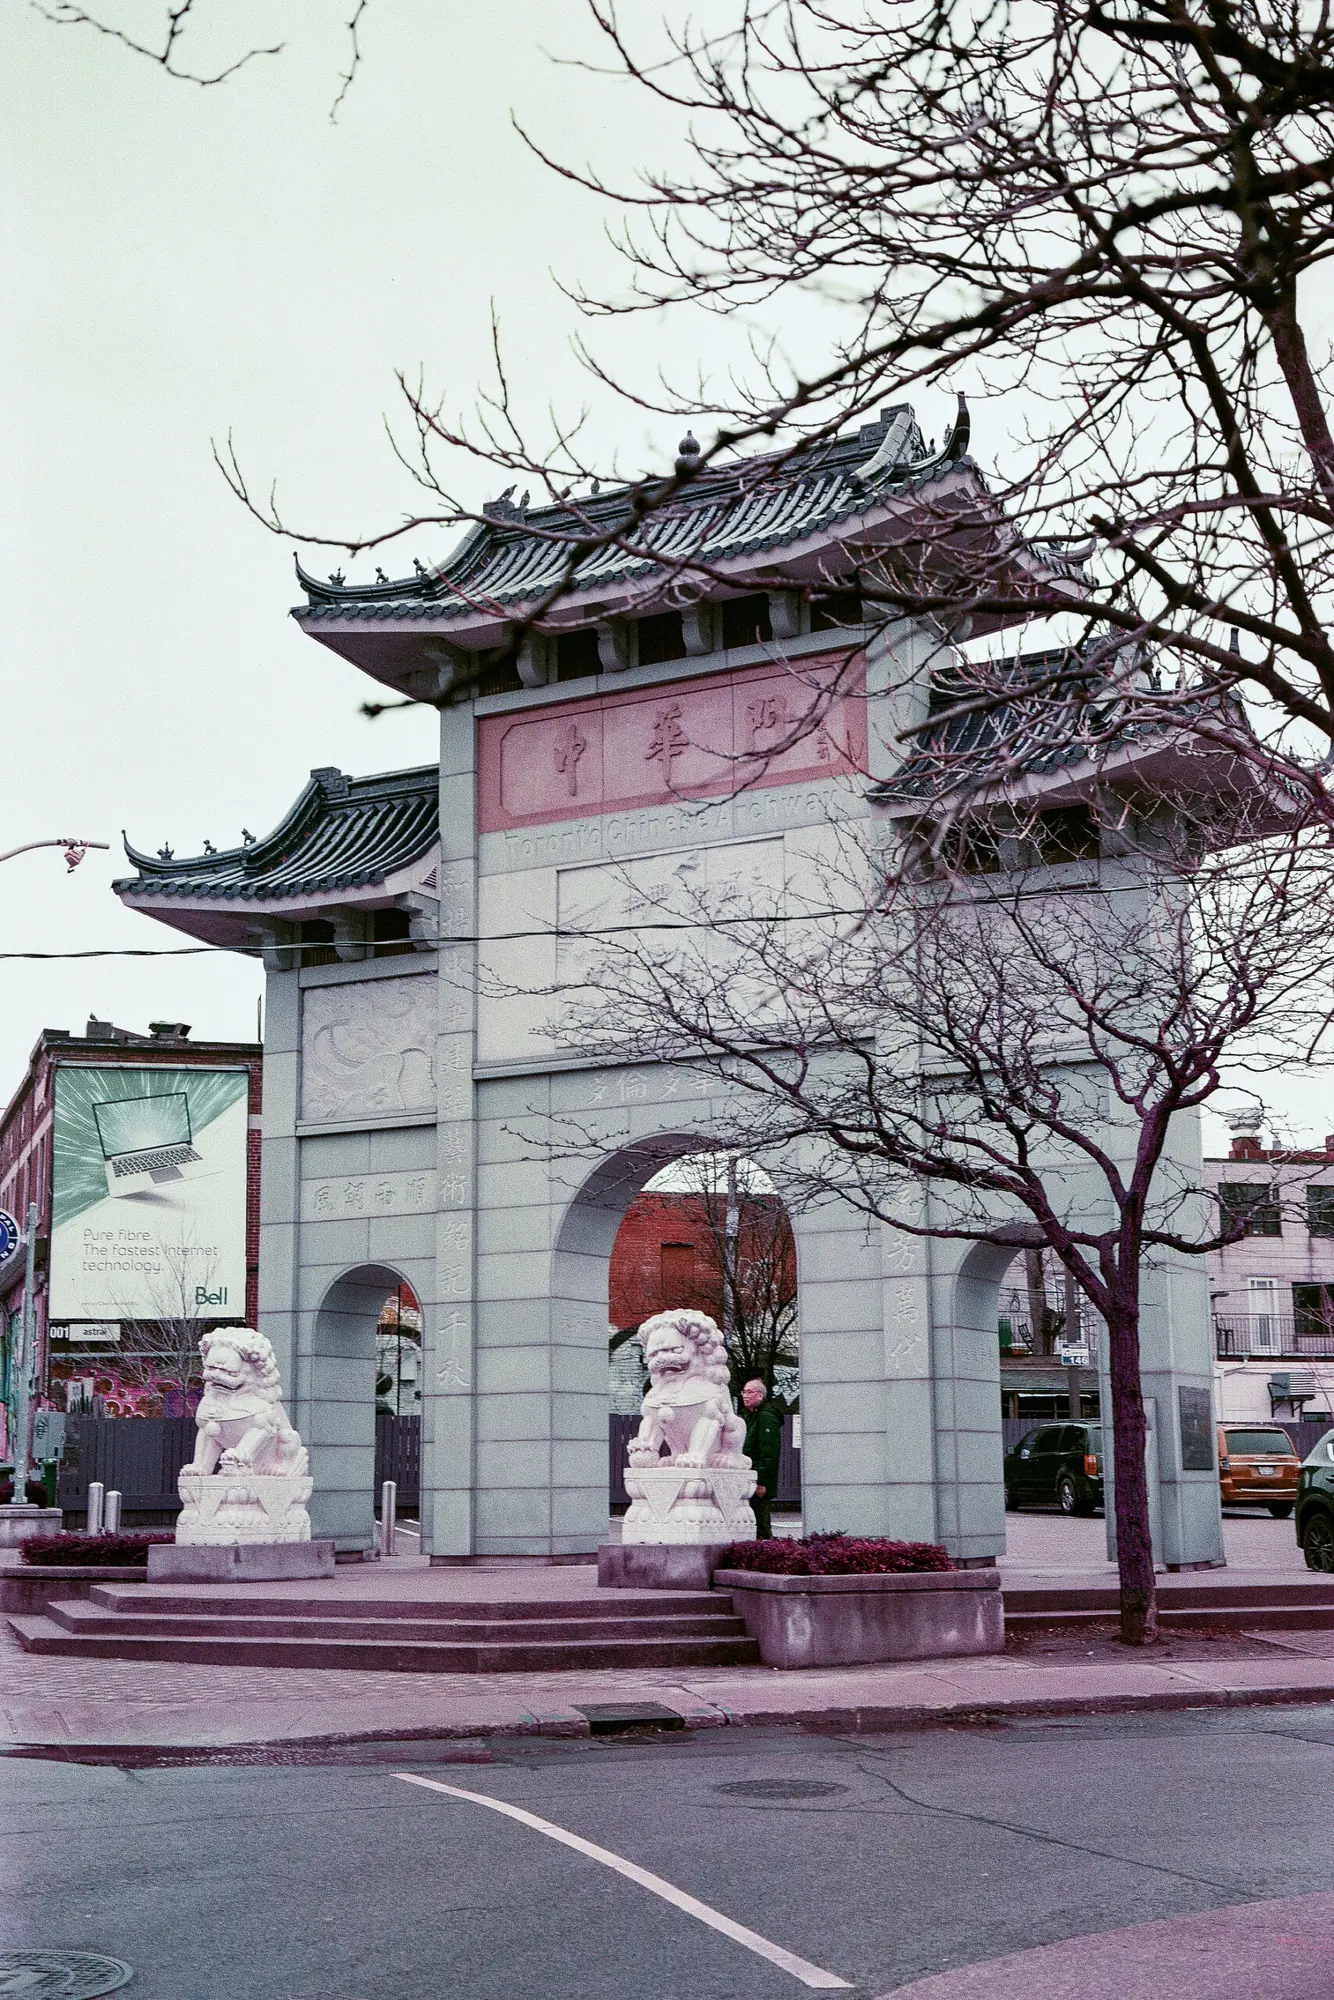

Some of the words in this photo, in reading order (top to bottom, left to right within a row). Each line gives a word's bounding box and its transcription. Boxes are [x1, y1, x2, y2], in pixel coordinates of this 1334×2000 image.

[505, 825, 599, 860] Toronto
[608, 811, 709, 843] Chinese
[716, 788, 838, 829] Archway
[83, 1228, 114, 1241] Pure
[119, 1228, 153, 1241] fibre.
[83, 1243, 108, 1256] The
[112, 1243, 160, 1256] fastest
[165, 1243, 219, 1256] Internet
[82, 1259, 164, 1275] technology.
[195, 1286, 228, 1305] Bell
